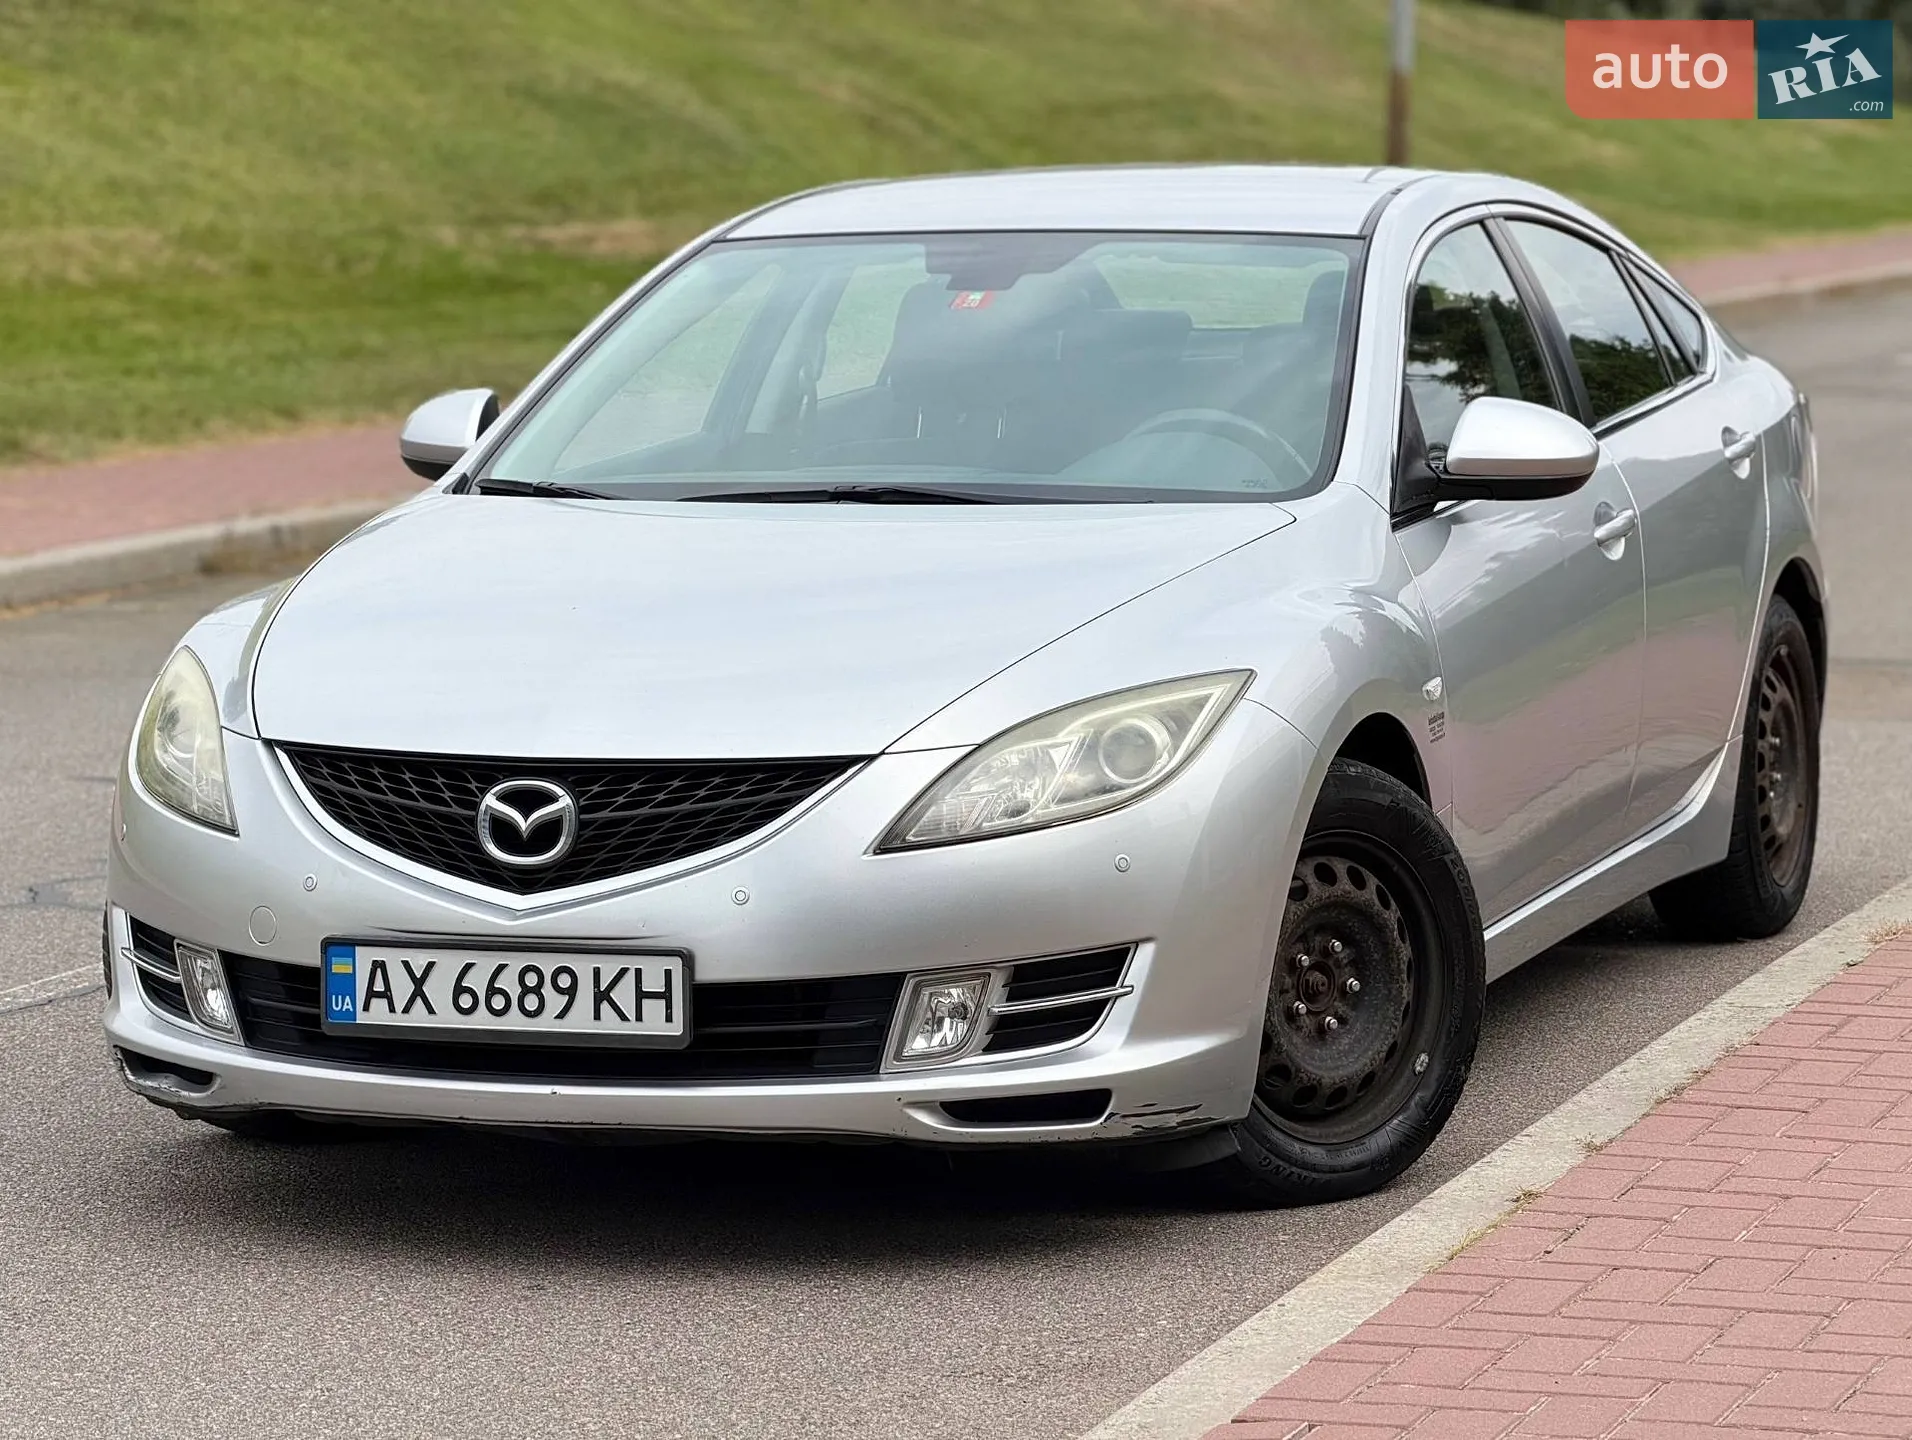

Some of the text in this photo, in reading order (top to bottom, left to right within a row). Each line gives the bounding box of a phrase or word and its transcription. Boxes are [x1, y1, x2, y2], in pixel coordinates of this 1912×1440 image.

[331, 994, 354, 1013] UA
[361, 958, 674, 1023] AX 6689 KH
